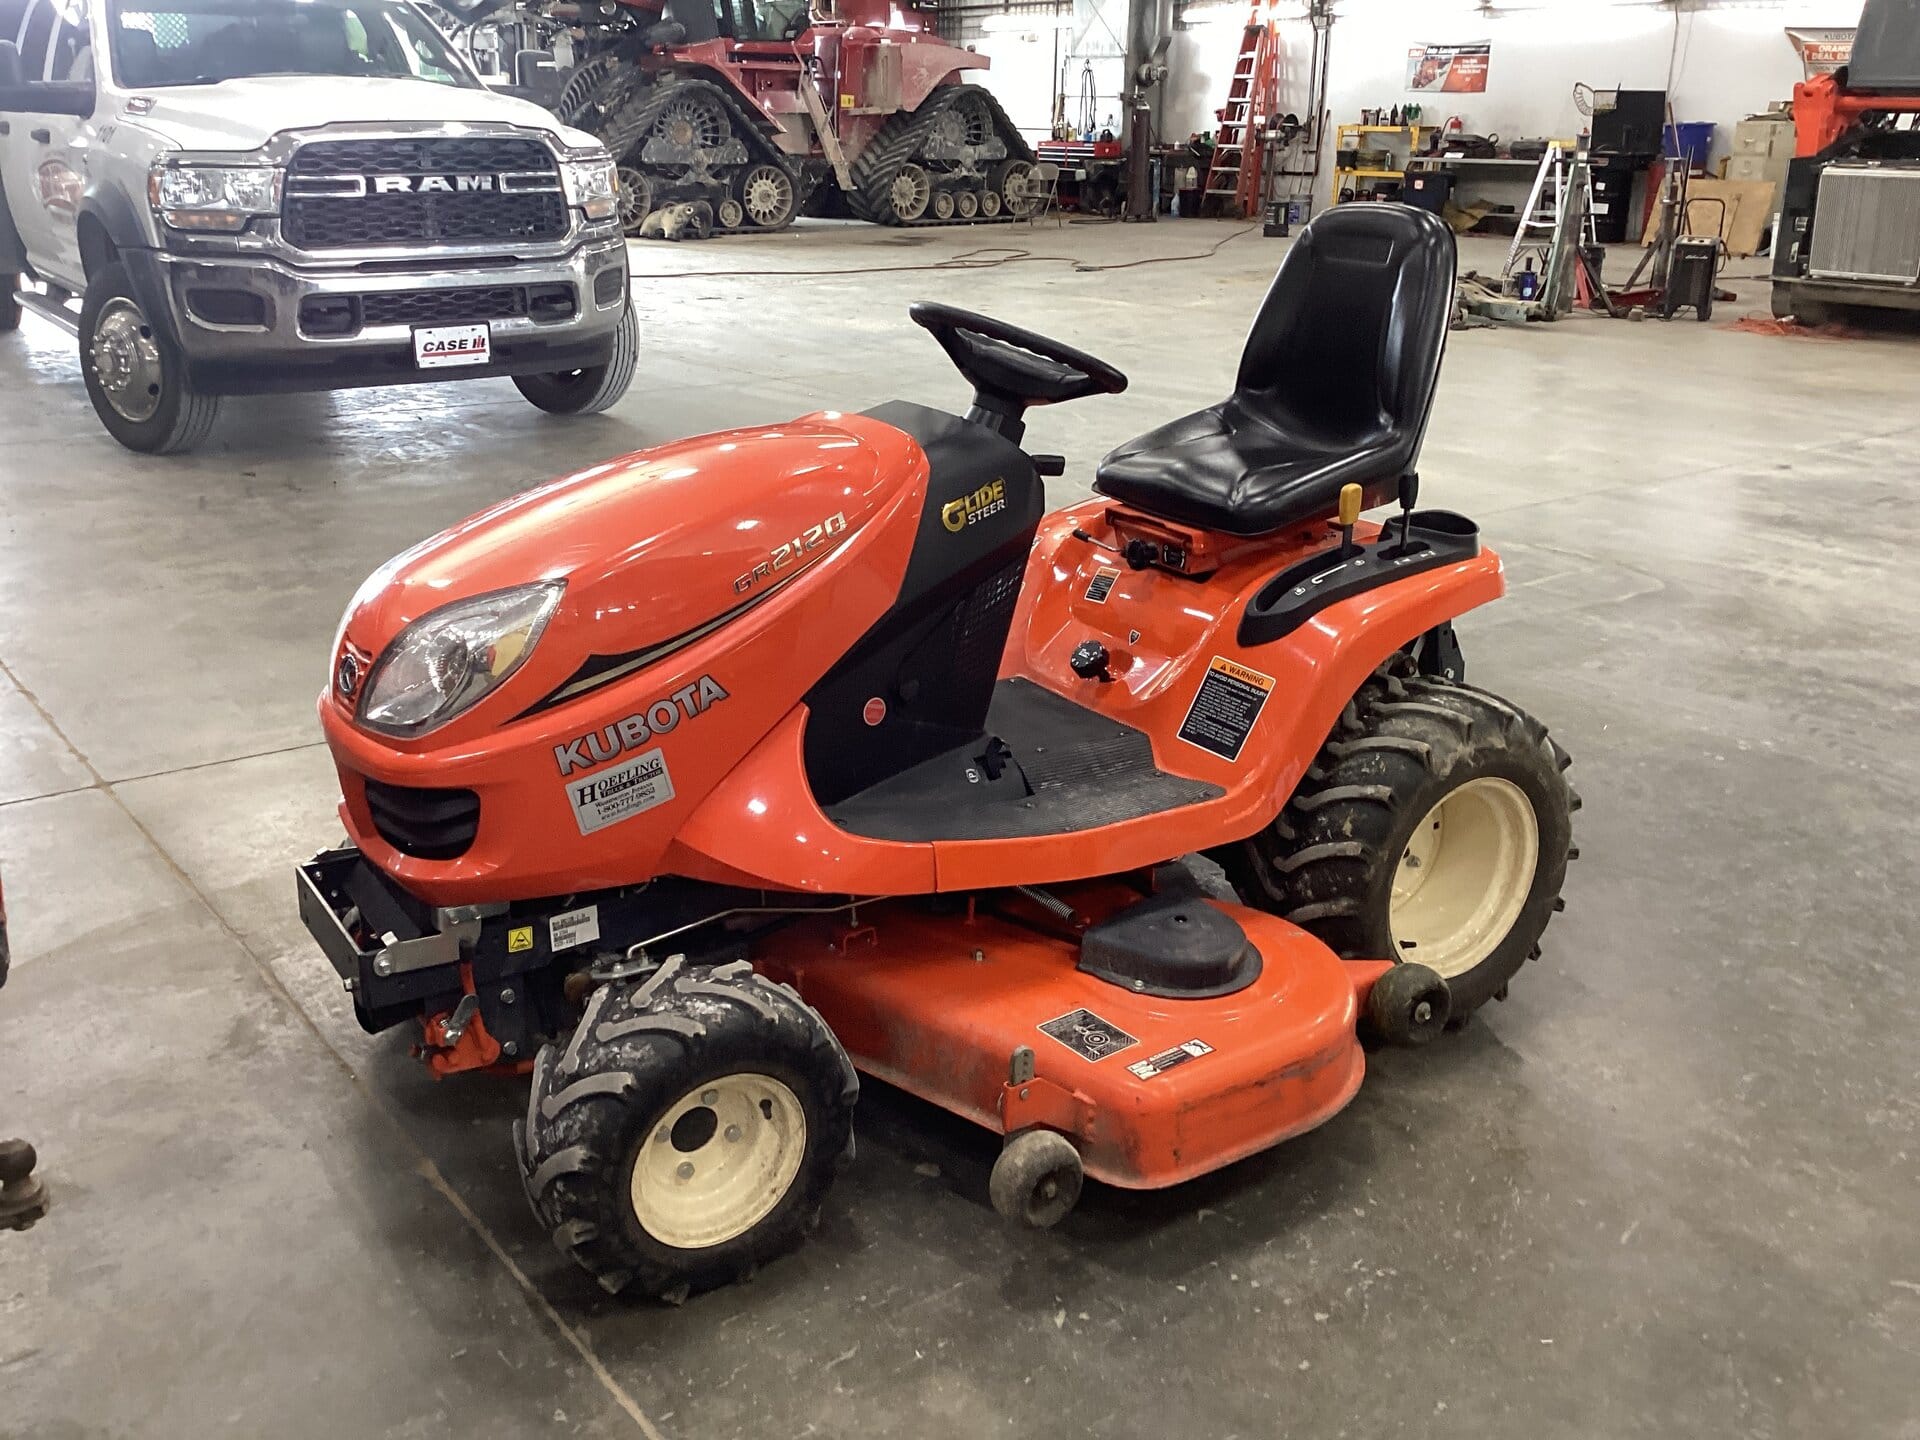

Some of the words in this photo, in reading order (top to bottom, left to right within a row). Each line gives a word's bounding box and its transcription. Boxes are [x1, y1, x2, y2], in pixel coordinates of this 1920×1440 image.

[1811, 52, 1835, 60] DEAL
[1836, 52, 1851, 60] DA
[1819, 45, 1852, 53] ORANG
[374, 175, 493, 193] RAM
[423, 339, 469, 352] CASE
[942, 479, 1004, 532] GLIDE
[967, 499, 1006, 525] STEER
[733, 511, 847, 593] GR2120
[1228, 666, 1265, 686] WARNING
[553, 673, 731, 777] KUBOTA
[575, 758, 661, 806] HOEFLING
